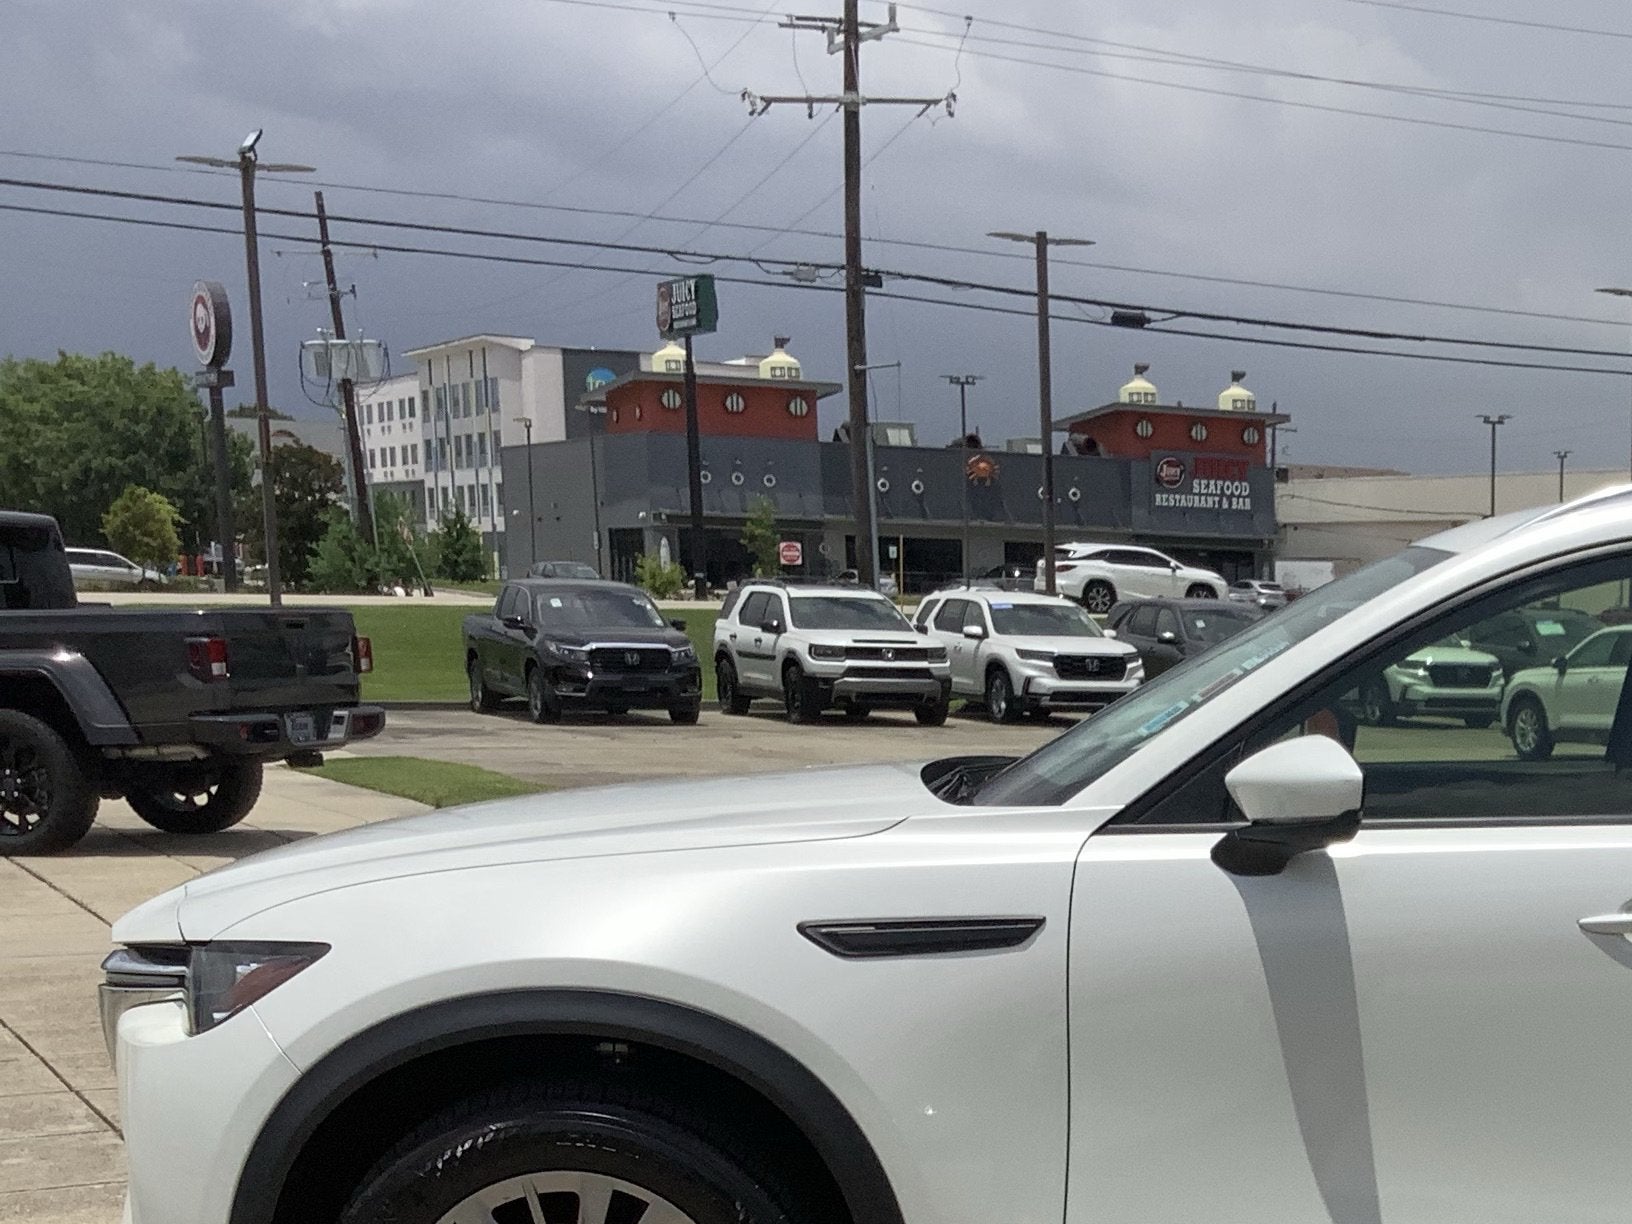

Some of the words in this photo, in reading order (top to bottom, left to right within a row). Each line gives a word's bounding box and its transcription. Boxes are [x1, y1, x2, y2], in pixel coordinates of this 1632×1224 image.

[671, 279, 696, 304] JUICY
[1192, 479, 1250, 496] SEAFOOD
[1155, 493, 1220, 508] RESTAURANT
[1222, 497, 1229, 509] &
[1232, 497, 1251, 510] BAR
